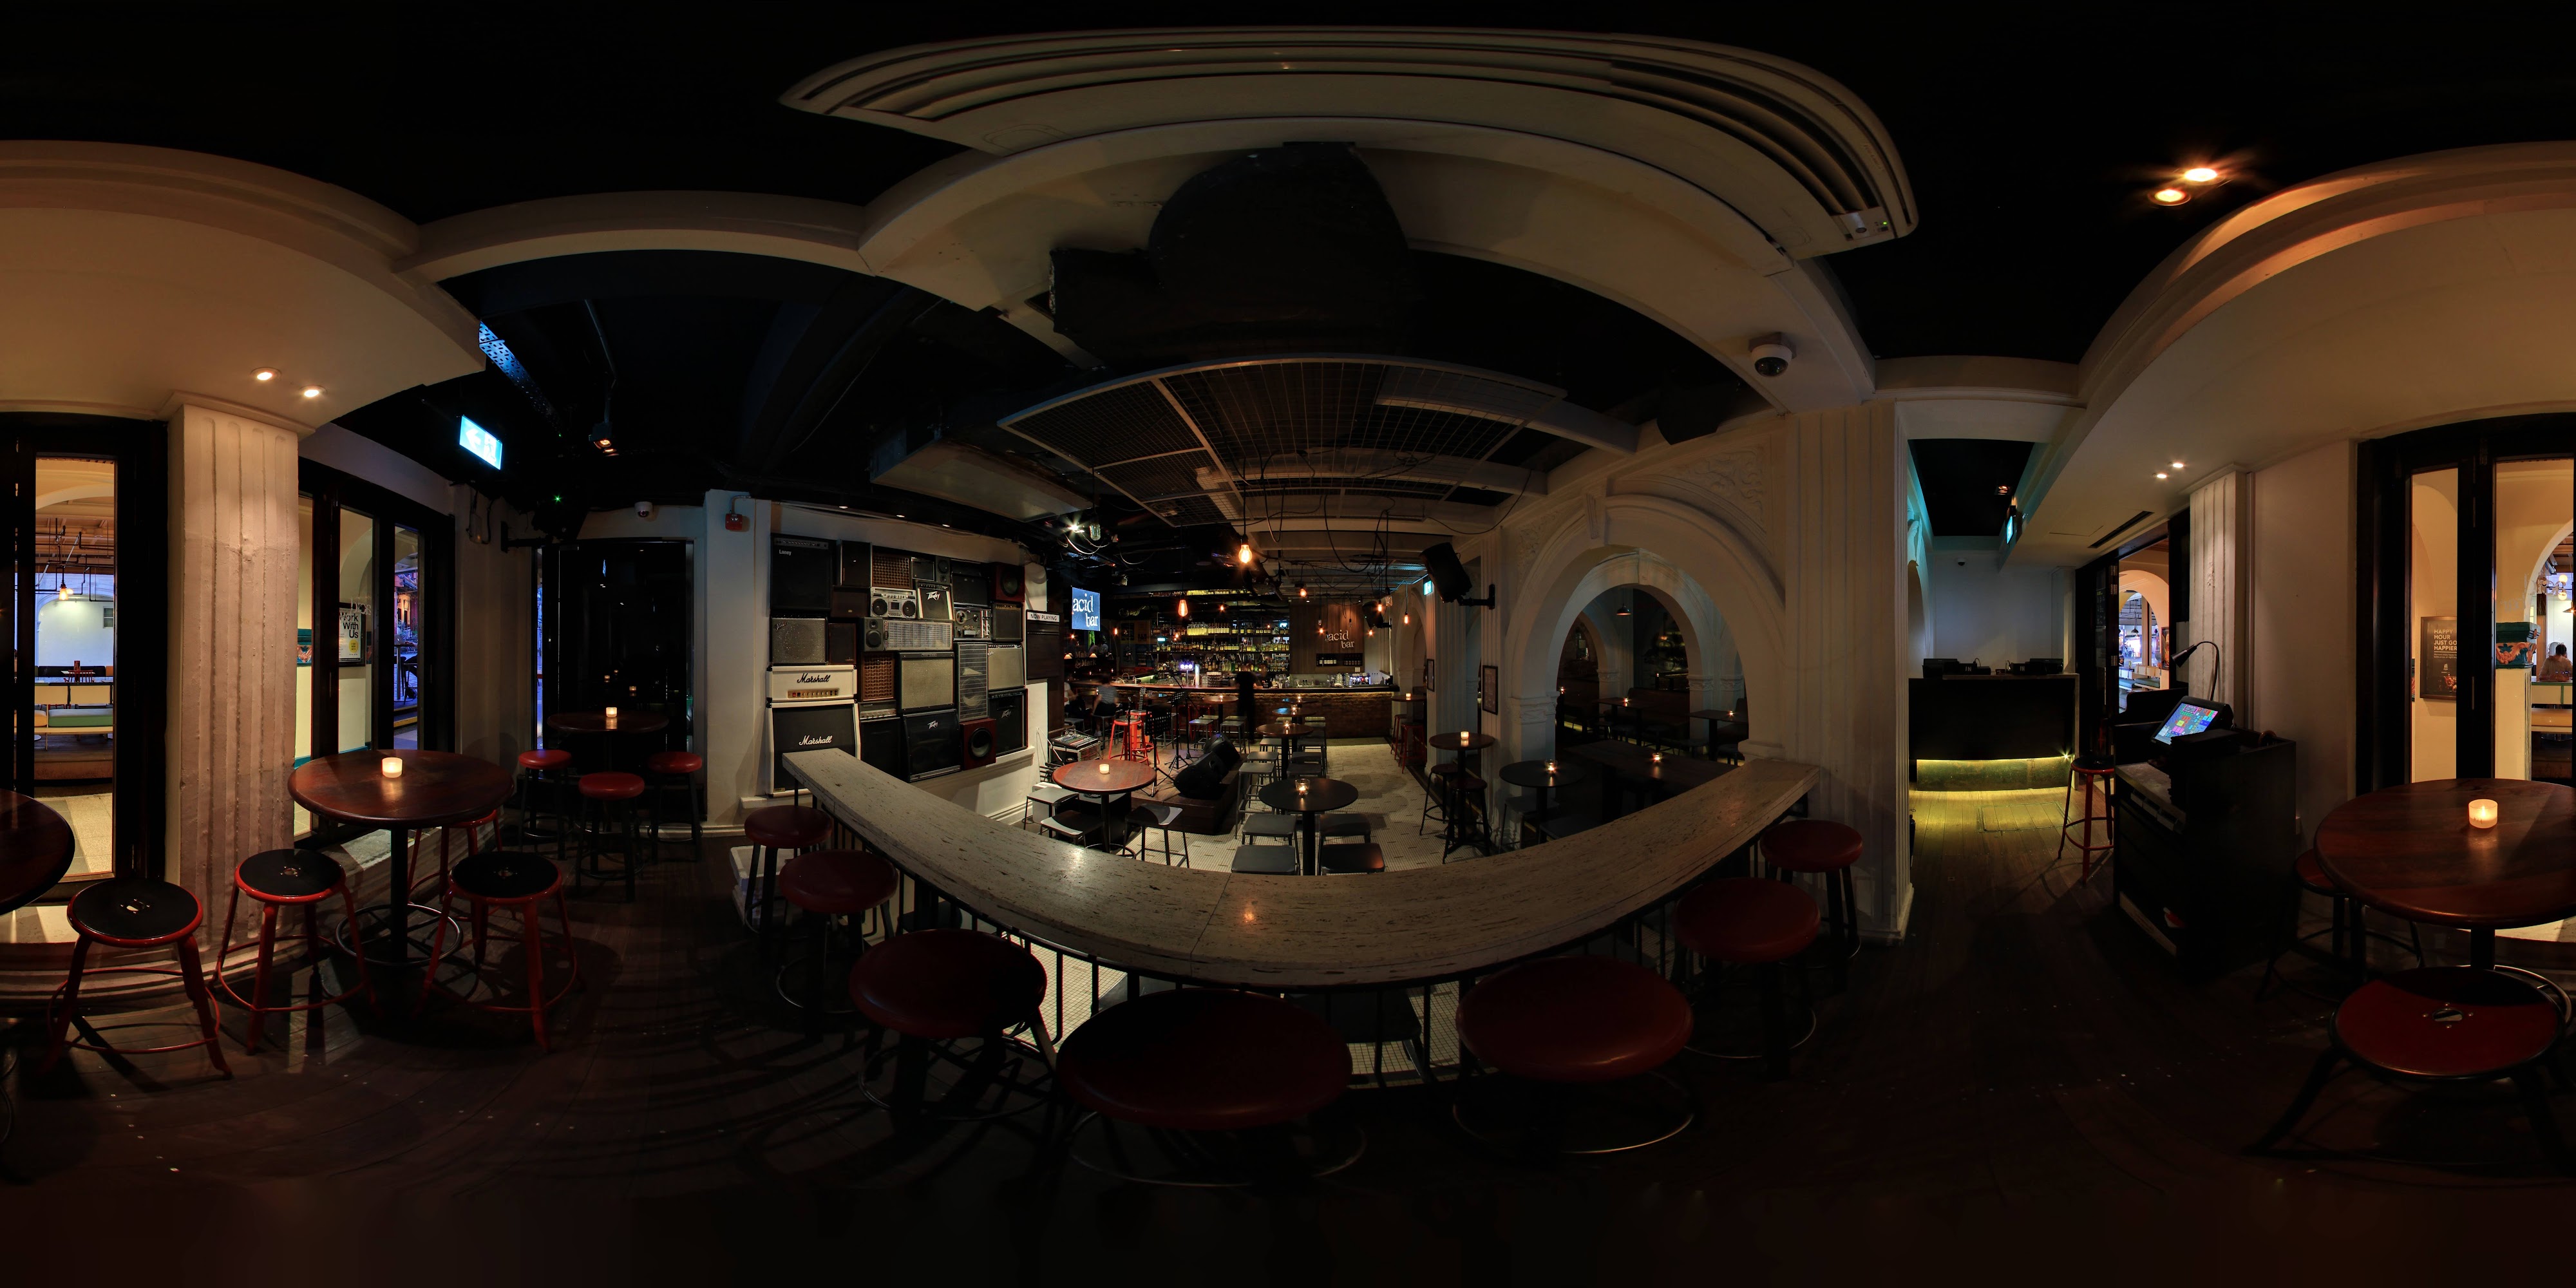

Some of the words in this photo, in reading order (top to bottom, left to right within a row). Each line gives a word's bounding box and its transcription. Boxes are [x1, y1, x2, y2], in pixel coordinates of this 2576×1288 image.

[1072, 593, 1094, 612] acid
[339, 612, 359, 622] Work
[1085, 613, 1099, 627] bar
[349, 630, 359, 638] Us
[1328, 629, 1349, 641] acid
[1341, 640, 1355, 649] bar
[797, 672, 831, 684] Marshall
[798, 735, 833, 746] Marshall
